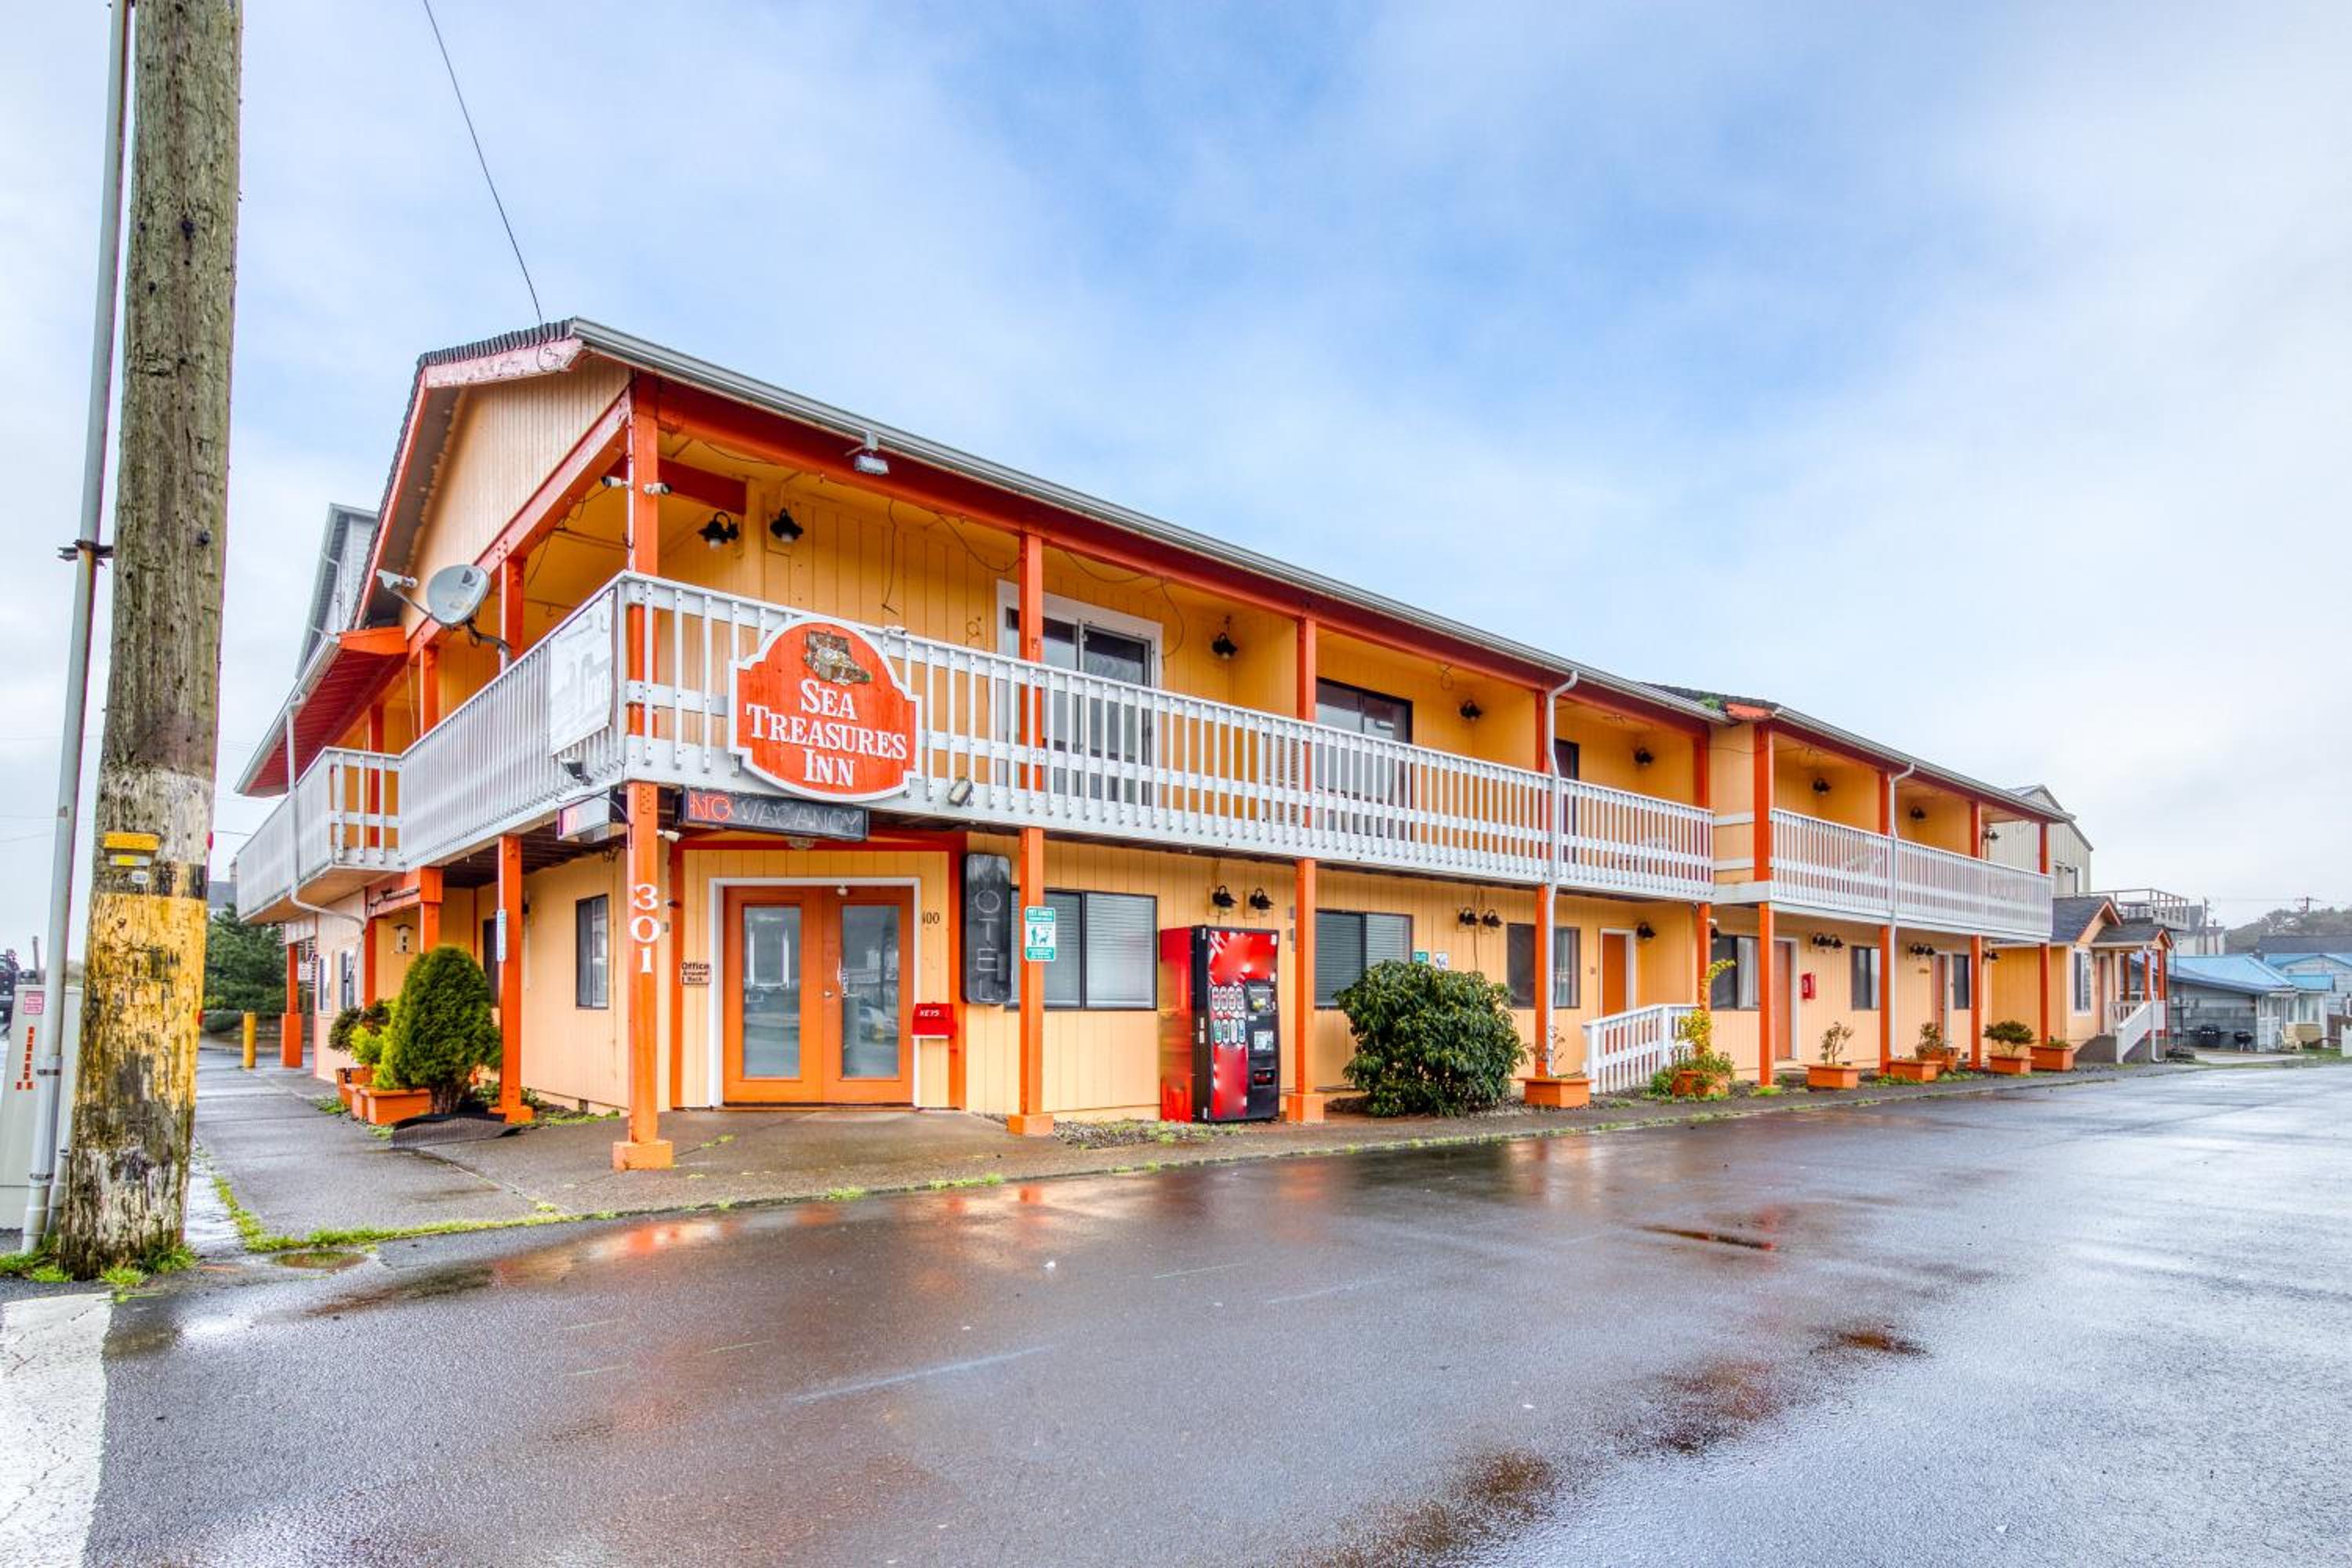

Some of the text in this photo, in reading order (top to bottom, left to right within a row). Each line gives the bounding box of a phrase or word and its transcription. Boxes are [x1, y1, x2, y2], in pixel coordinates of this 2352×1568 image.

[800, 678, 858, 720] SEA
[746, 703, 906, 760] TREASURES
[804, 748, 855, 787] INN
[690, 793, 859, 832] NO VACANCY
[630, 884, 660, 973] 301
